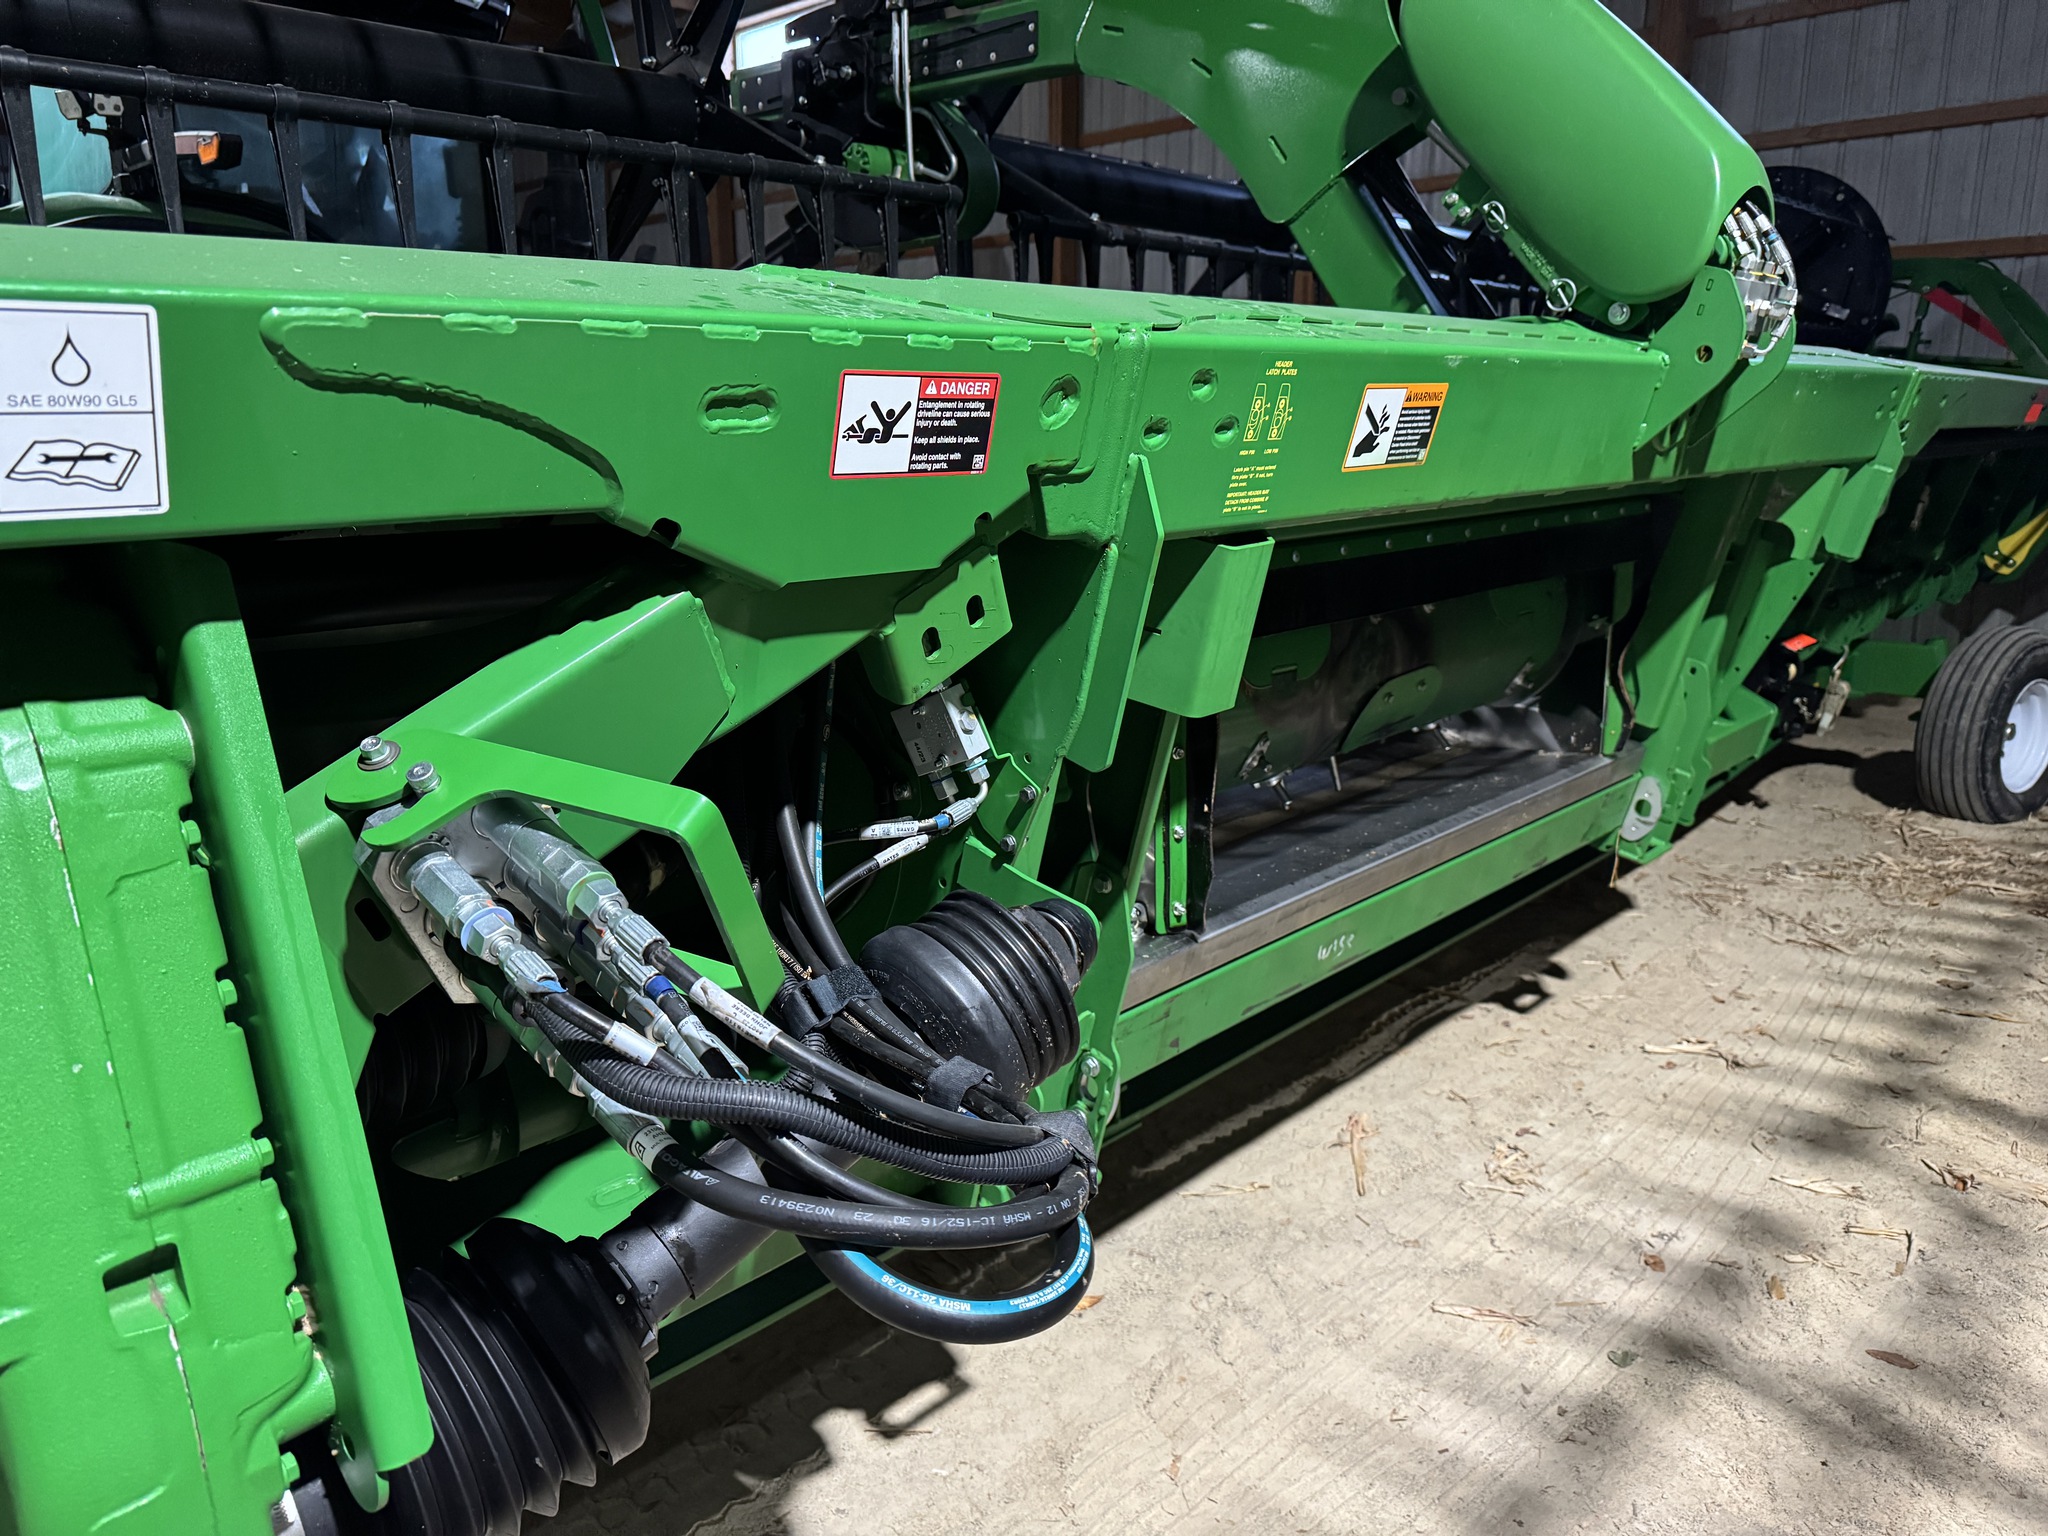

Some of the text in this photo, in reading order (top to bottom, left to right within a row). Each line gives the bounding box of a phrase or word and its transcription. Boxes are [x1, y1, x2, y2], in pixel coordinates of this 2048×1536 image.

[940, 382, 990, 395] DANGER
[7, 394, 138, 408] SAE 80W90 GL5
[1412, 392, 1443, 402] WARNING
[918, 401, 956, 410] Entanglement
[964, 402, 985, 410] rotating
[916, 419, 932, 428] injury
[914, 436, 928, 445] Keep
[963, 436, 980, 444] place.
[910, 462, 931, 471] rotating
[913, 741, 926, 763] 44/23
[883, 853, 899, 863] GATES
[731, 1004, 750, 1018] DEERE
[751, 1017, 768, 1029] JOHN
[853, 1211, 873, 1222] 23
[1002, 1210, 1031, 1223] MSHA
[1046, 1204, 1057, 1217] 12
[881, 1274, 971, 1311] MSHA 2G-11C/36
